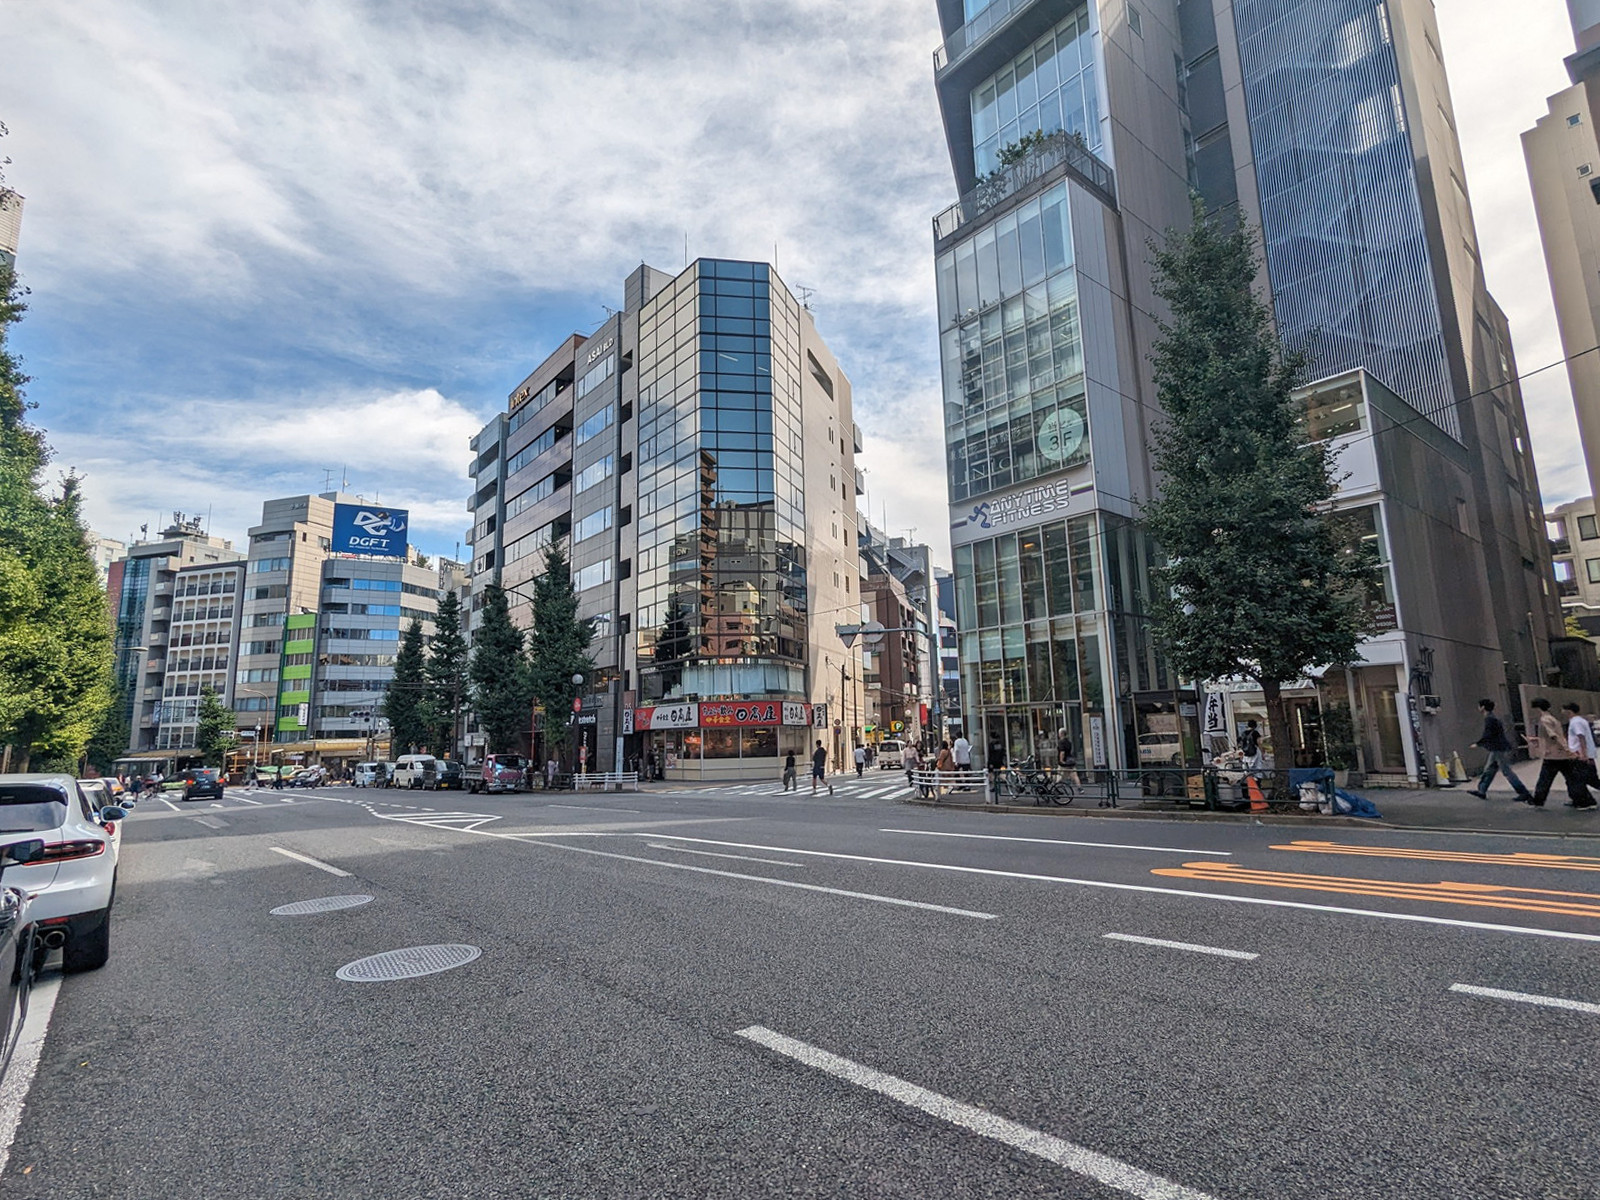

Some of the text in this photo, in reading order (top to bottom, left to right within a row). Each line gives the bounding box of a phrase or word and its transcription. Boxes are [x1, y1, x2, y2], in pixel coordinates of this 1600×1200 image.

[587, 344, 603, 366] ASAI
[1049, 431, 1072, 451] 3F
[989, 478, 1069, 515] ANYTIME
[991, 495, 1070, 527] FITNESS
[349, 536, 390, 547] DGFT
[670, 706, 693, 723] 日高屋
[735, 704, 777, 722] 日高屋
